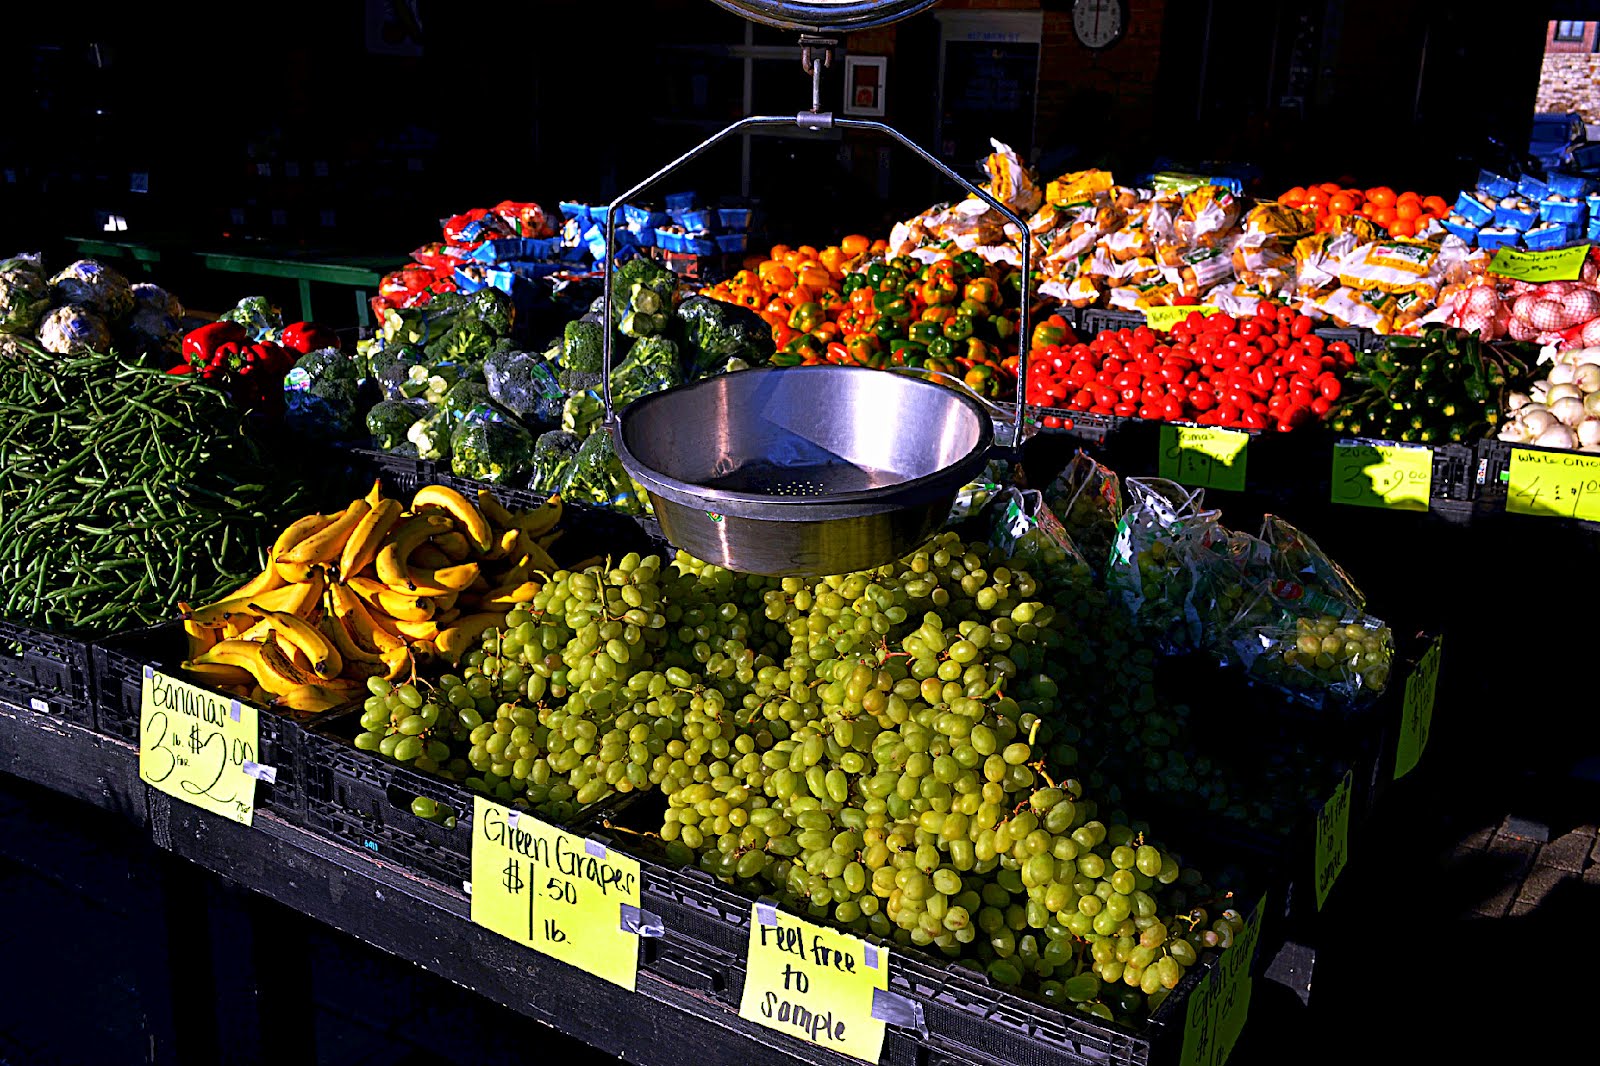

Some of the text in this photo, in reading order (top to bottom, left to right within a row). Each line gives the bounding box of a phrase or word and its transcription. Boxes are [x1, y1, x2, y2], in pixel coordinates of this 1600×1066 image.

[152, 673, 226, 728] Bananas
[146, 711, 175, 782] 3
[484, 808, 635, 895] Green Grapes
[761, 922, 856, 974] Feel free
[781, 963, 809, 994] to
